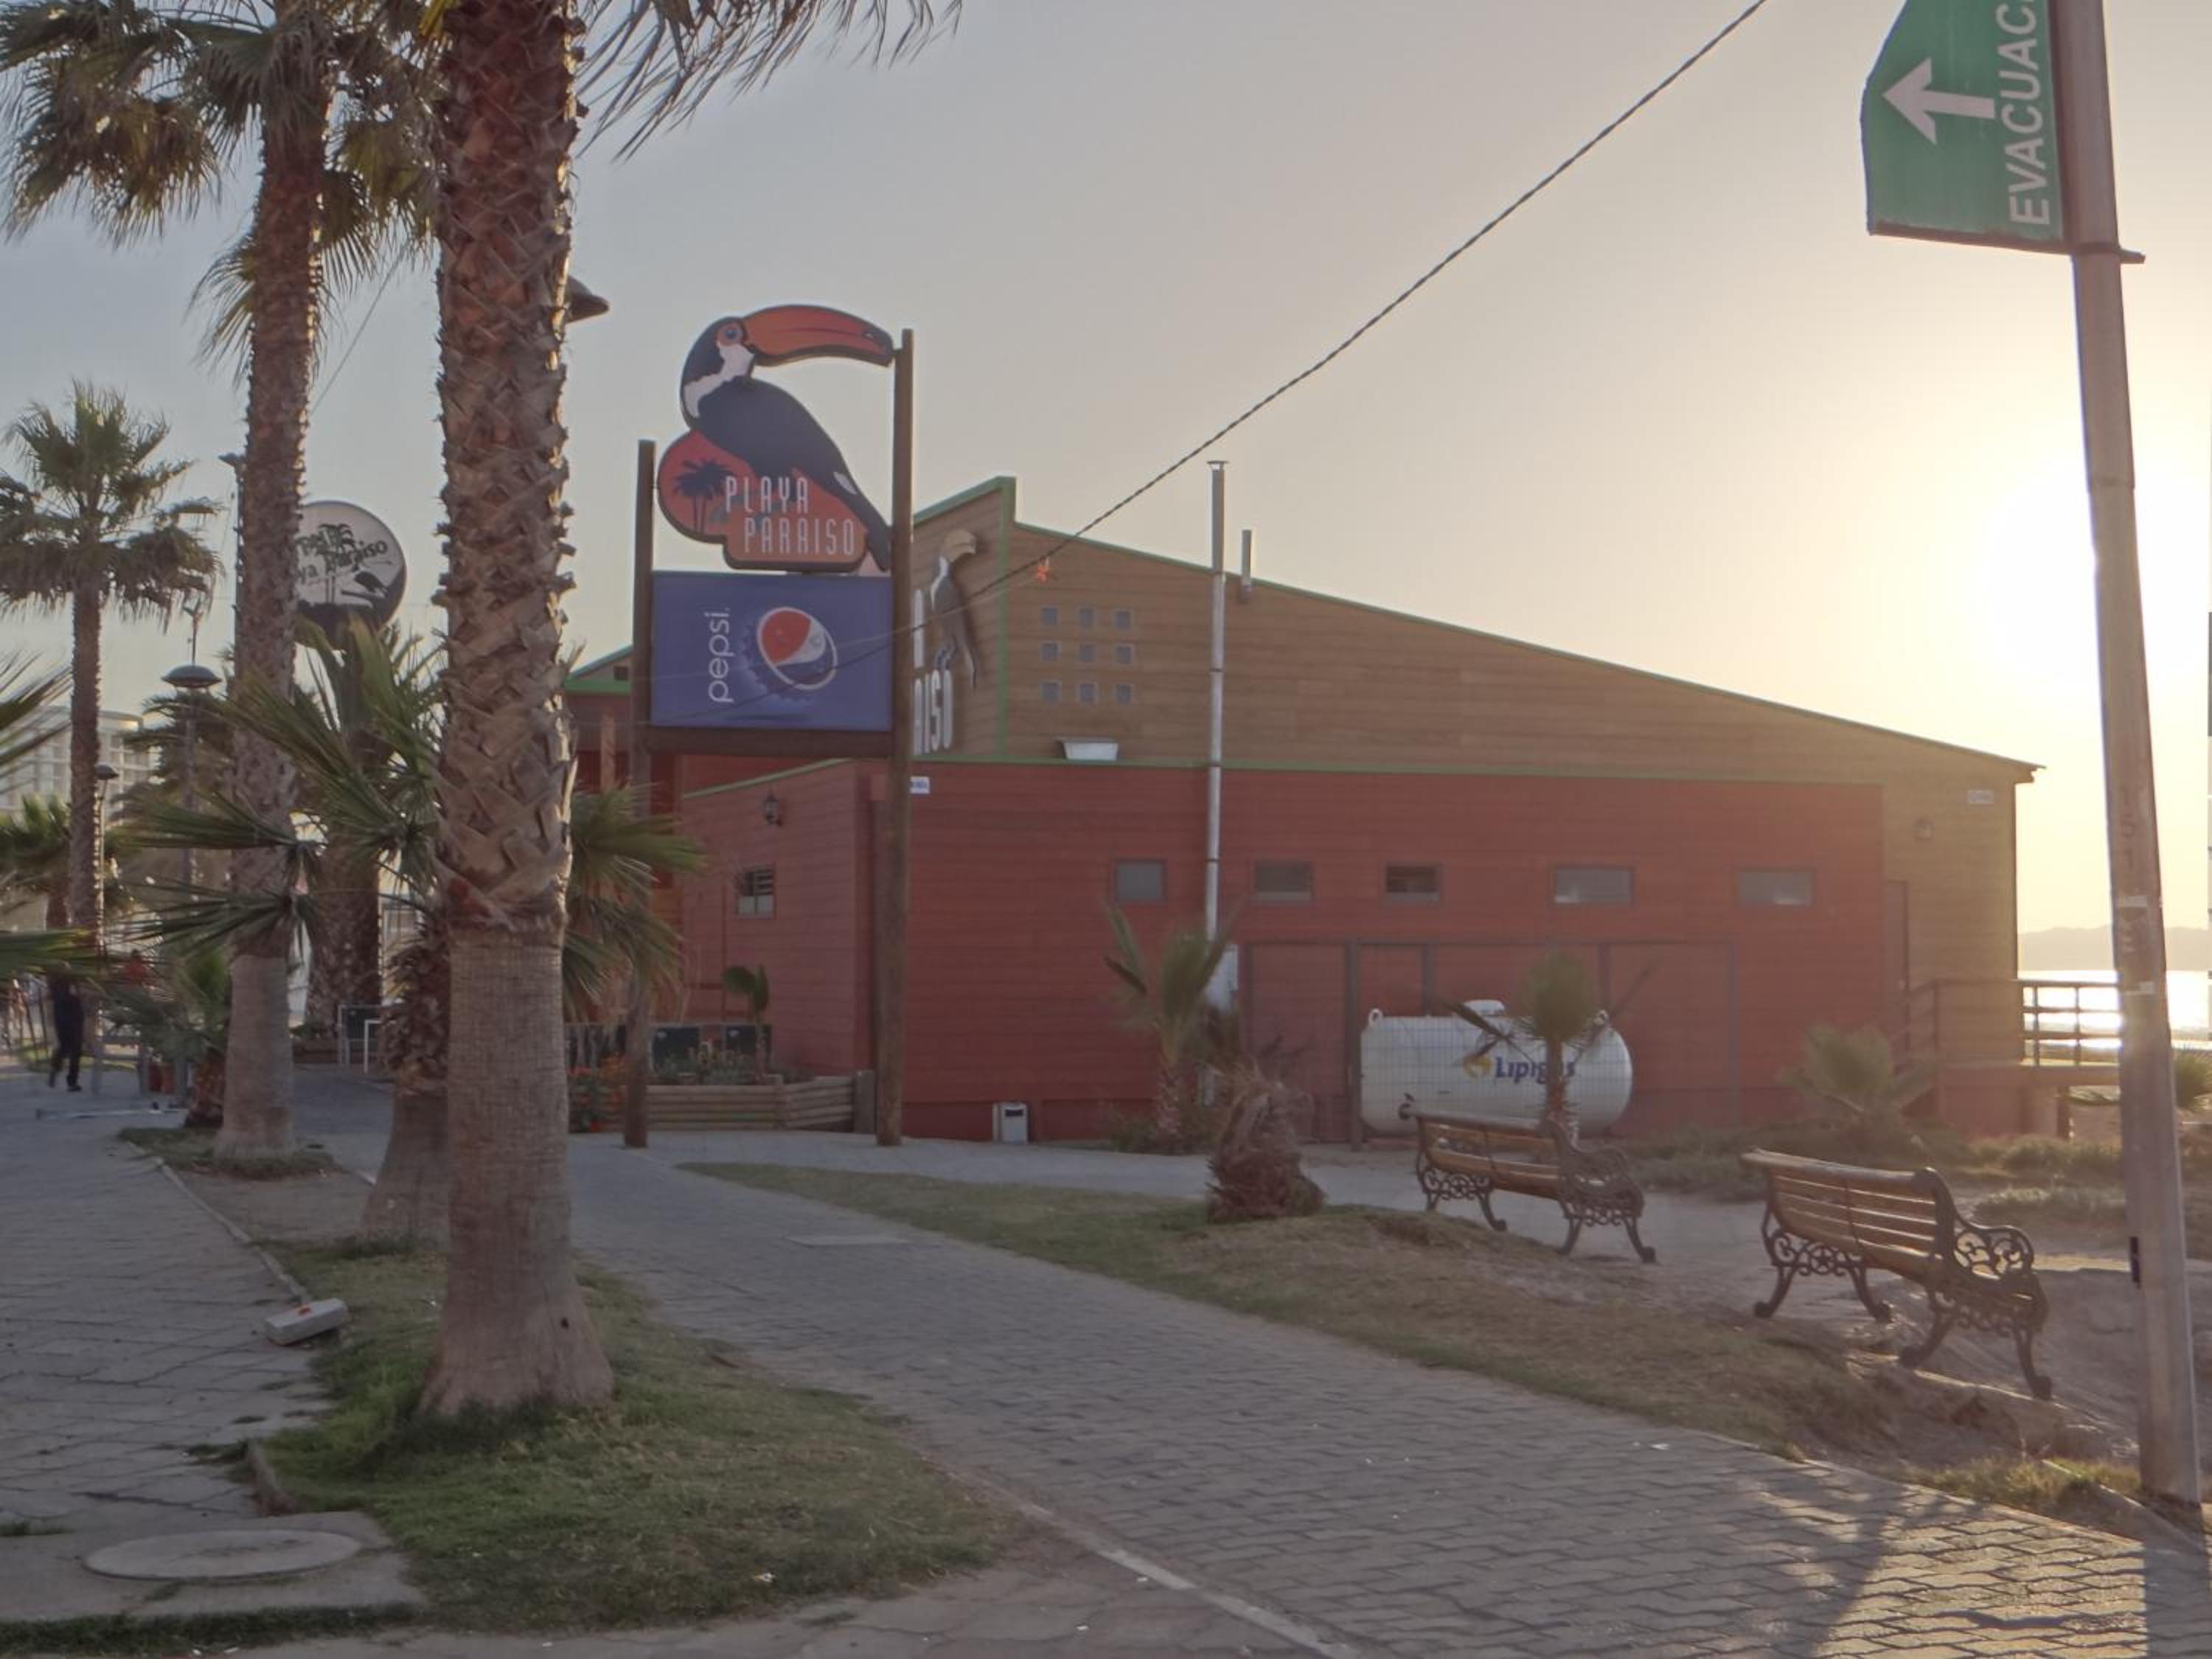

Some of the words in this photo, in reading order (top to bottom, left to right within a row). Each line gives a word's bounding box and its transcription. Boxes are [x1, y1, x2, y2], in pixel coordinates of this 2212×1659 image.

[1995, 0, 2050, 225] EVACUAC
[726, 476, 810, 513] PLAYA
[745, 518, 854, 554] PARAISO
[704, 611, 735, 703] pepsi
[1495, 1057, 1576, 1085] Lipigs
